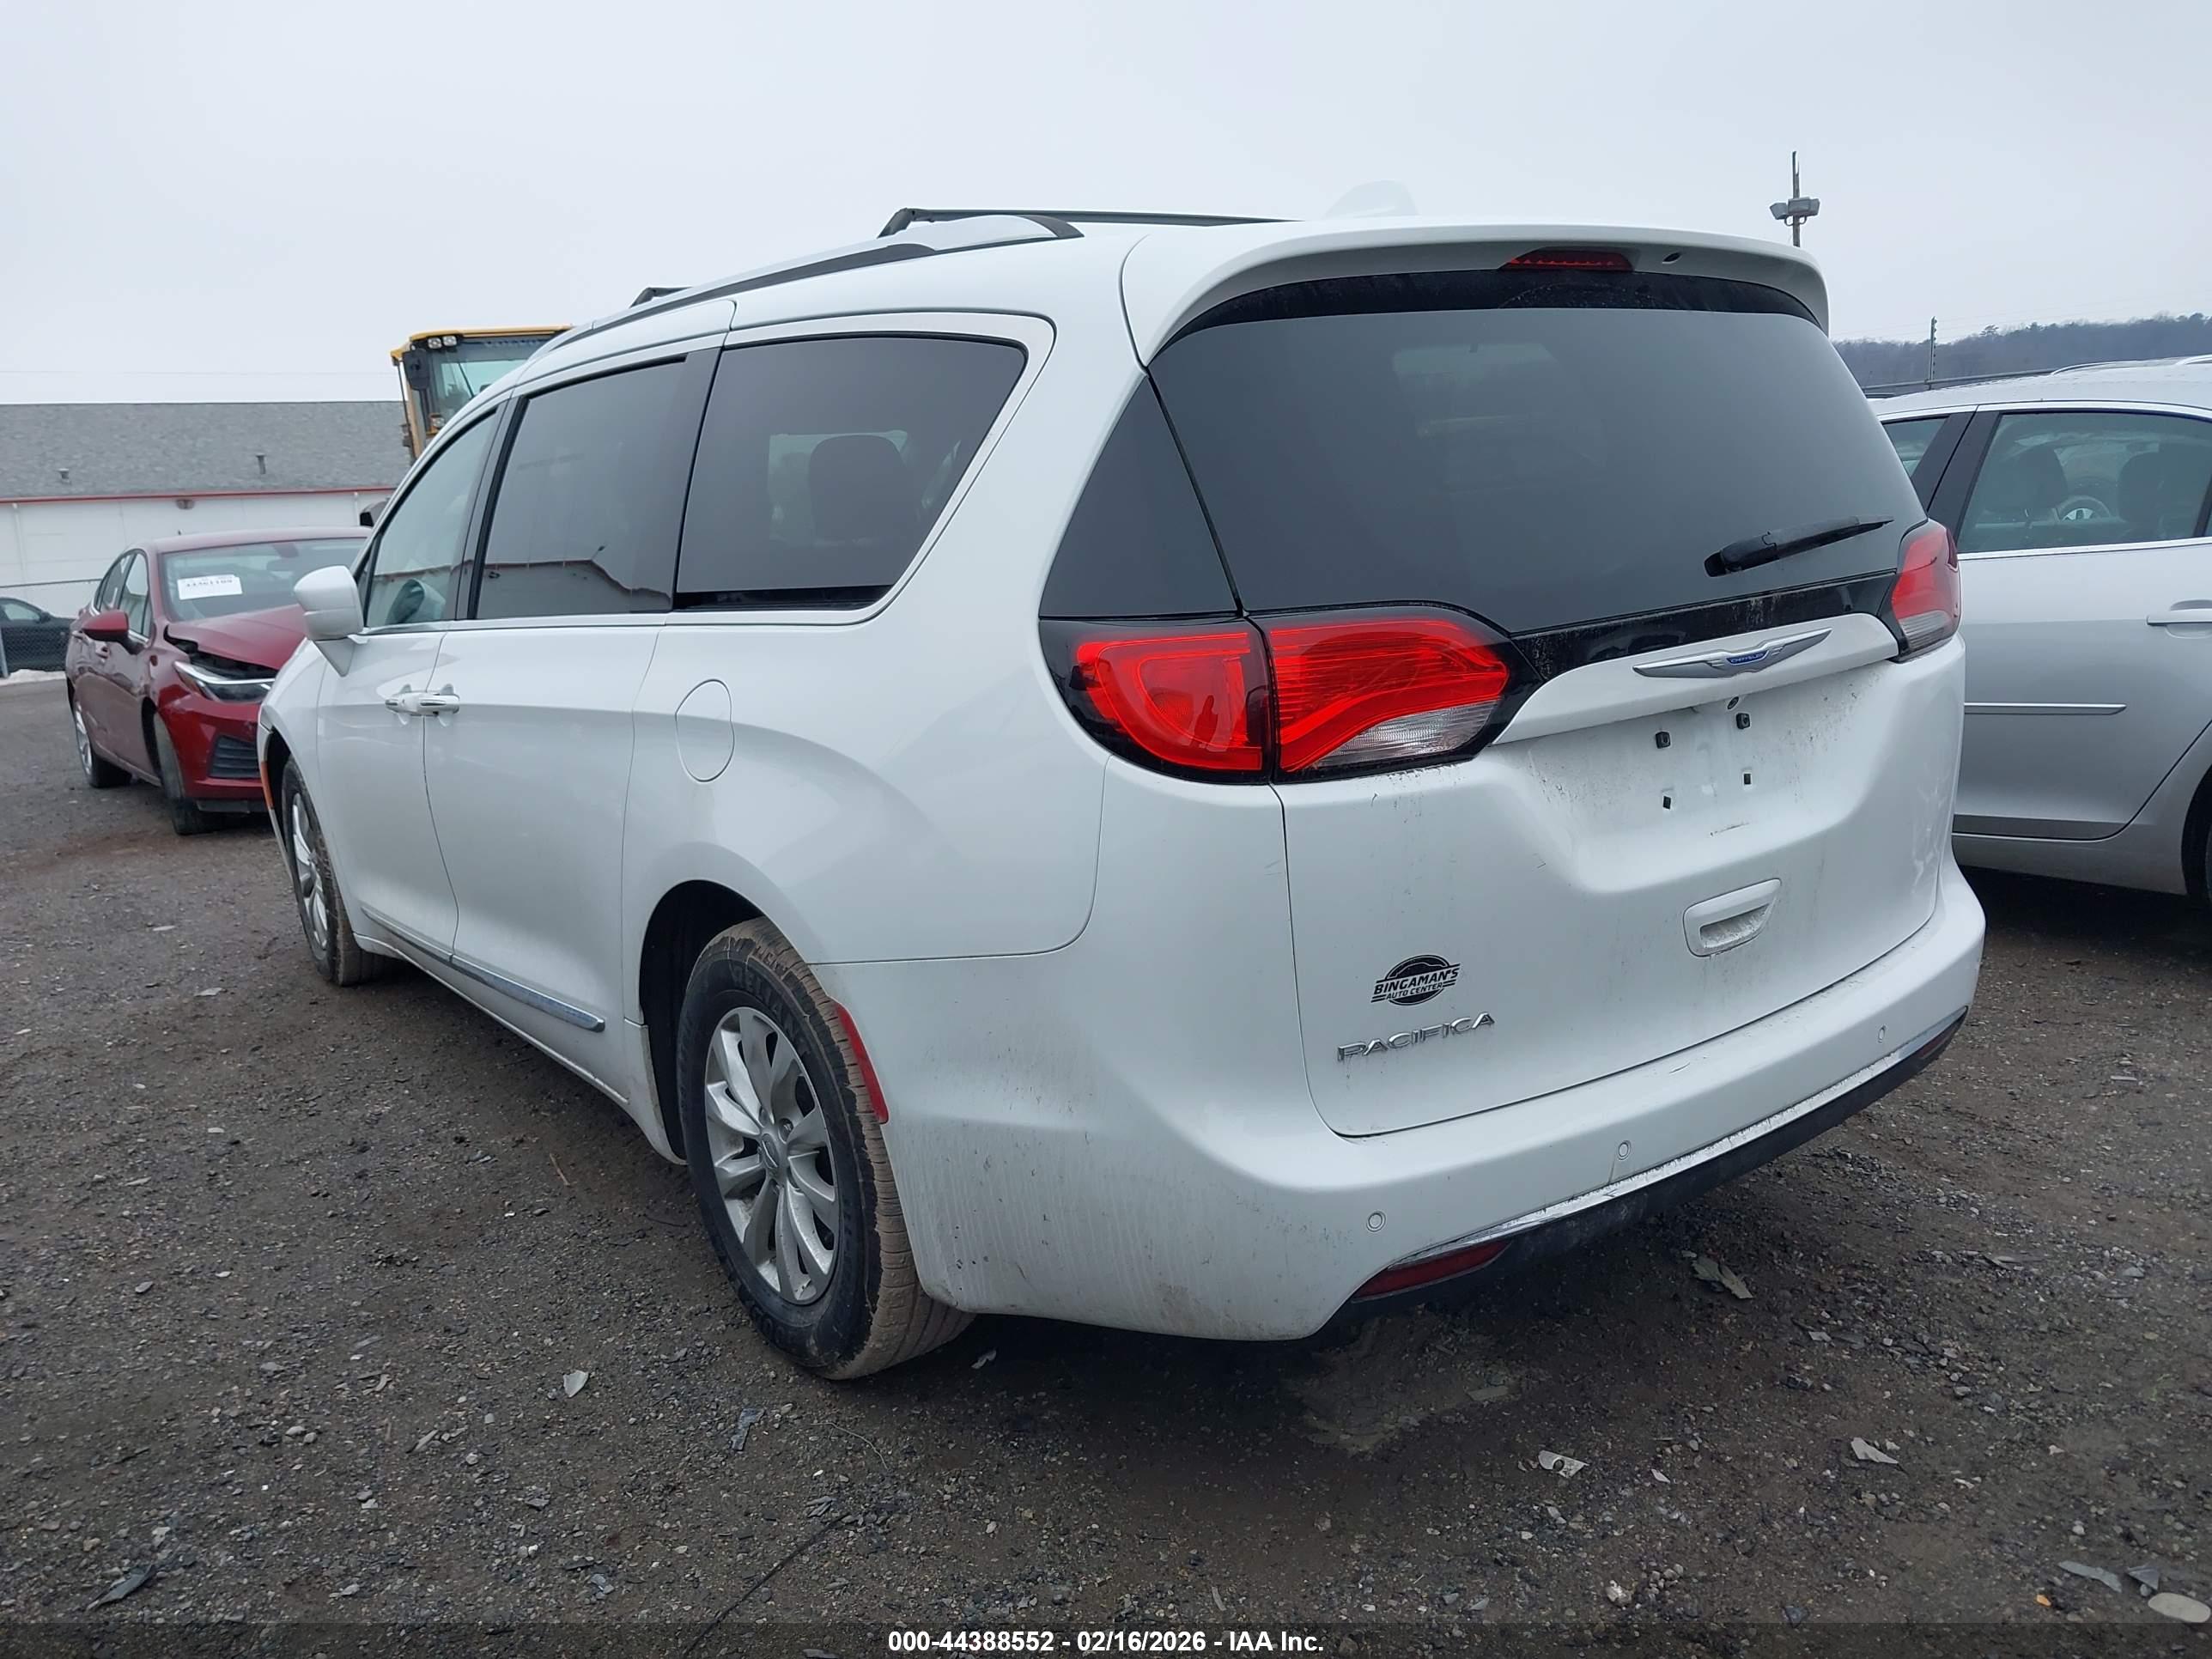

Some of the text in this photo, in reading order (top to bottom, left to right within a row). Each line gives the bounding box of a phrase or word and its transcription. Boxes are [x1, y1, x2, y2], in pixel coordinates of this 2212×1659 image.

[1374, 968, 1460, 995] BINGAMAN'S
[1386, 981, 1443, 1000] AUTO CENTER
[1337, 1012, 1495, 1062] PACIFICA
